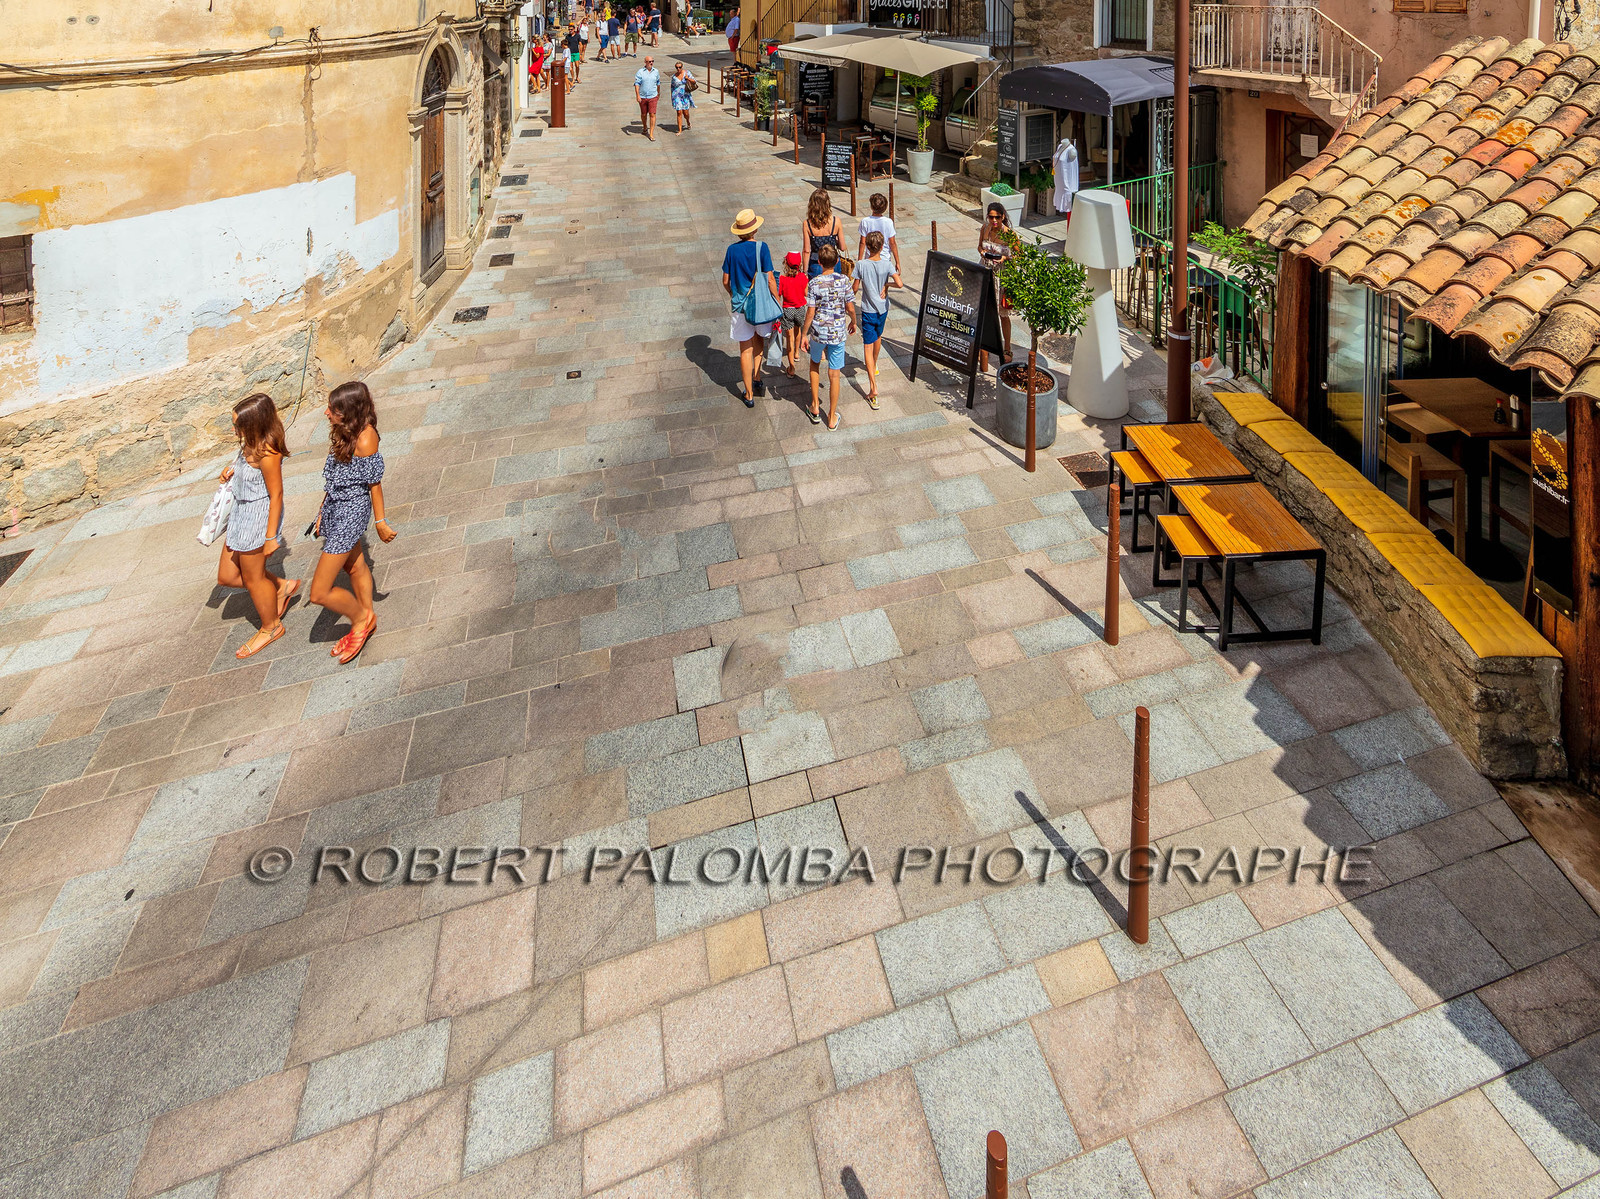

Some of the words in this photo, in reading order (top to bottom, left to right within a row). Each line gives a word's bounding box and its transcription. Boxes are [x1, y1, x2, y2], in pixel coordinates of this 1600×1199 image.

[927, 306, 939, 316] UNE
[930, 293, 974, 315] sushibar.fr
[951, 320, 970, 335] SUSHI
[1532, 477, 1570, 505] sushibar.fr
